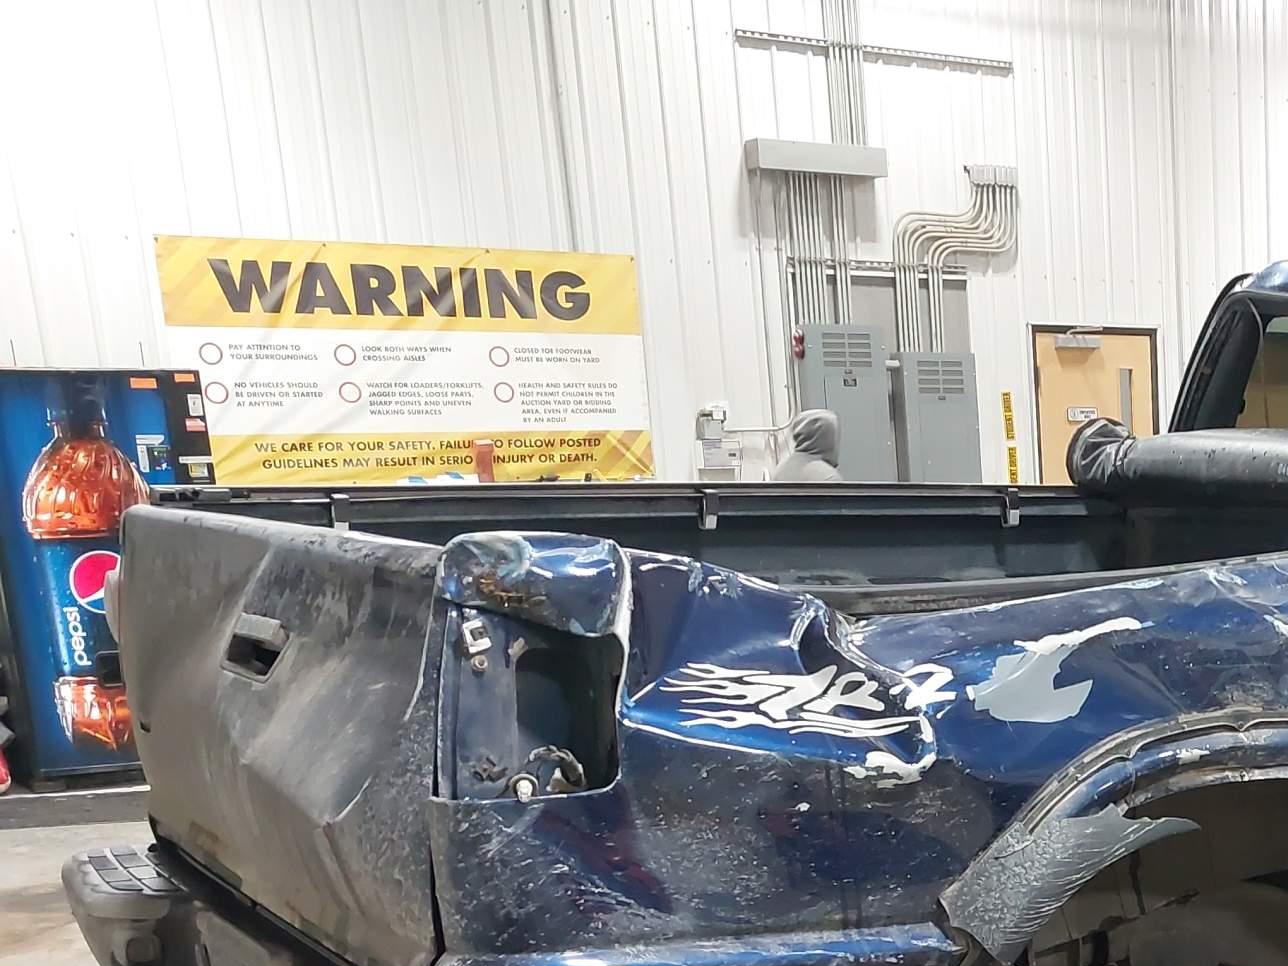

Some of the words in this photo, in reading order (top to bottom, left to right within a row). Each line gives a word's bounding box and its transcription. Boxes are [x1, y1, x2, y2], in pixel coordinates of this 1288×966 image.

[207, 258, 591, 321] WARNING
[228, 343, 243, 351] PAY
[246, 343, 288, 351] ATTENTION
[361, 345, 383, 353] LOOK
[254, 353, 318, 361] SURROUNDINGS
[362, 354, 401, 362] CROSSING
[403, 354, 426, 362] AISLES
[255, 443, 276, 453] WE
[281, 442, 313, 452] CARE
[318, 441, 343, 451] FOR
[348, 441, 384, 451] YOUR
[389, 440, 436, 450] SAFETY.
[440, 440, 475, 450] FAILU
[508, 438, 556, 448] FOLLOW
[559, 438, 601, 447] POSTED
[262, 458, 338, 469] GUIDELINES
[342, 457, 371, 468] MAY
[375, 456, 418, 467] RESULT
[422, 456, 435, 466] IN
[440, 455, 473, 465] SERIO
[493, 454, 534, 464] INJURY
[538, 454, 555, 463] OR
[559, 453, 598, 463] DEATH.
[63, 606, 92, 666] pepsi
